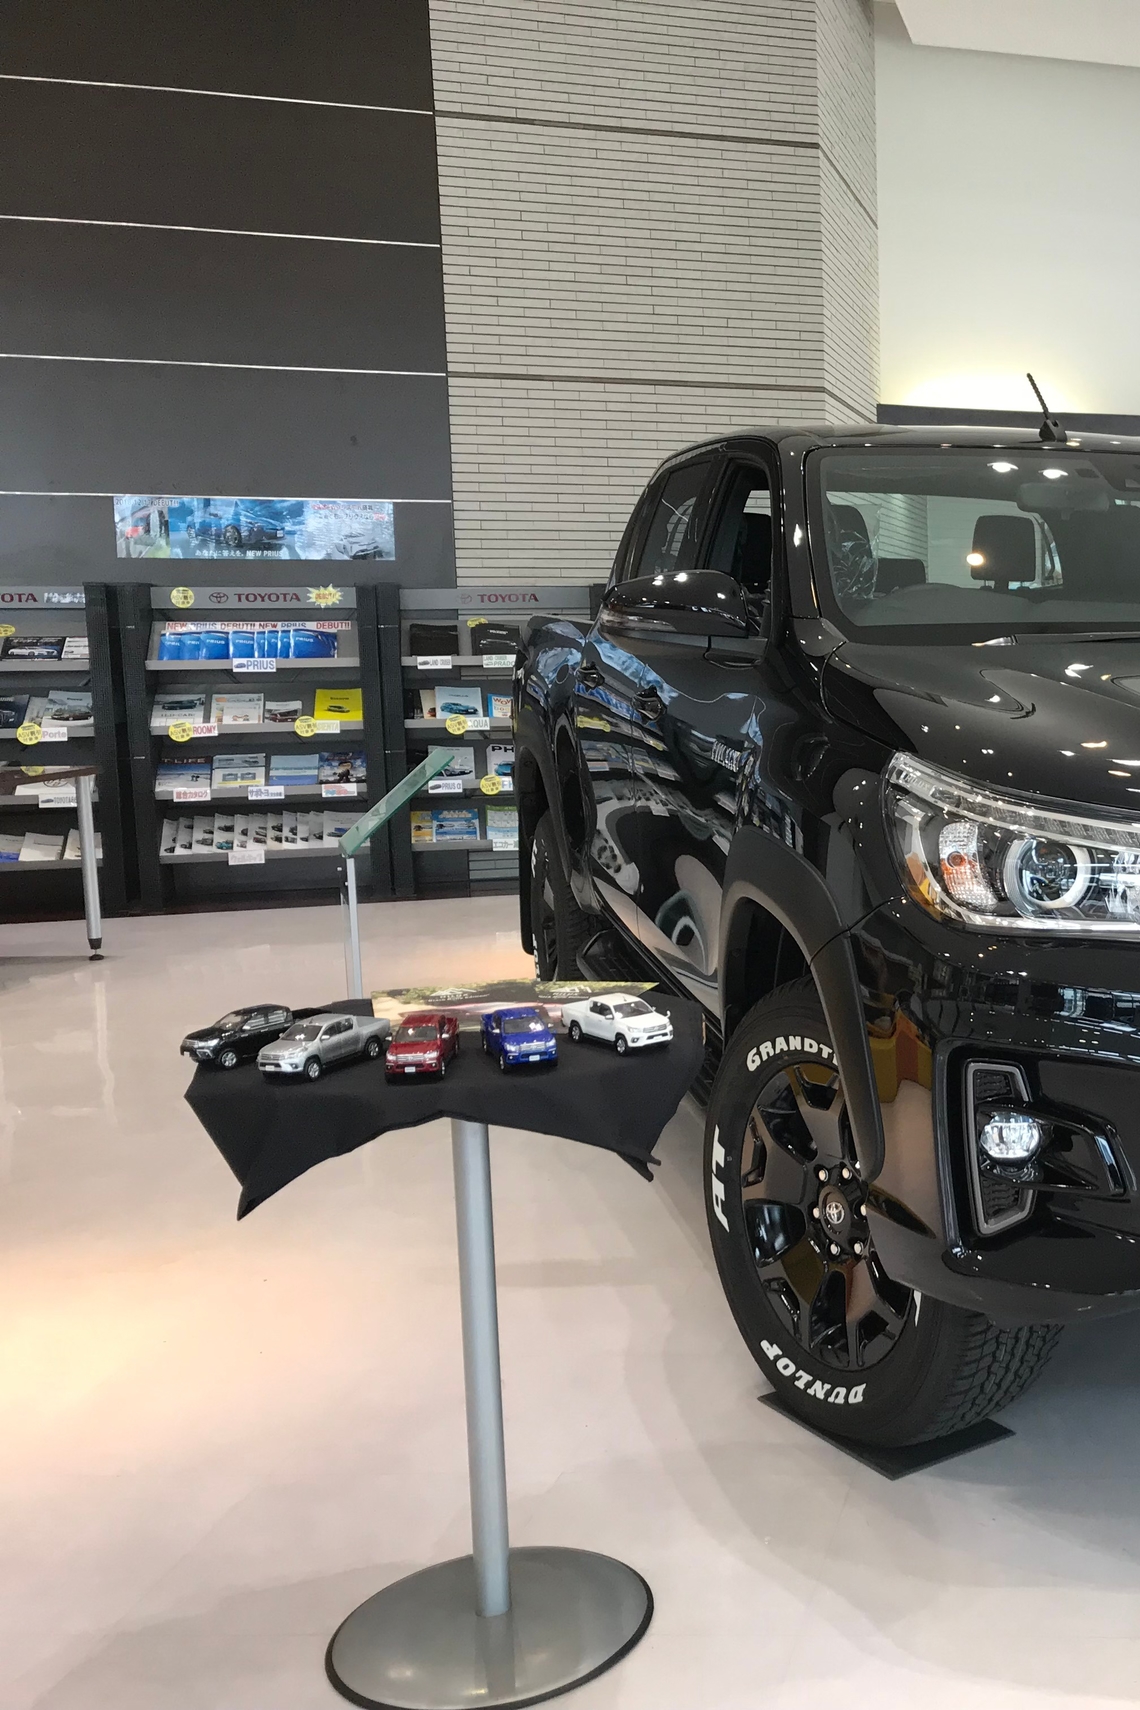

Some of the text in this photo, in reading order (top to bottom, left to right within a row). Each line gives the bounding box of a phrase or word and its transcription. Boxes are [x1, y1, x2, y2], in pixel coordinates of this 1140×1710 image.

[0, 592, 39, 603] OTA
[233, 592, 301, 603] TOYOTA
[477, 593, 539, 603] TOYOTA
[167, 622, 187, 630] NEW
[259, 622, 278, 630] NEW
[316, 621, 350, 630] DEBUT!!
[246, 660, 275, 671] PRIUS
[42, 730, 67, 739] Porte
[192, 724, 217, 735] ROOMY
[711, 1123, 730, 1233] AT
[760, 1339, 867, 1405] DUNLOP
